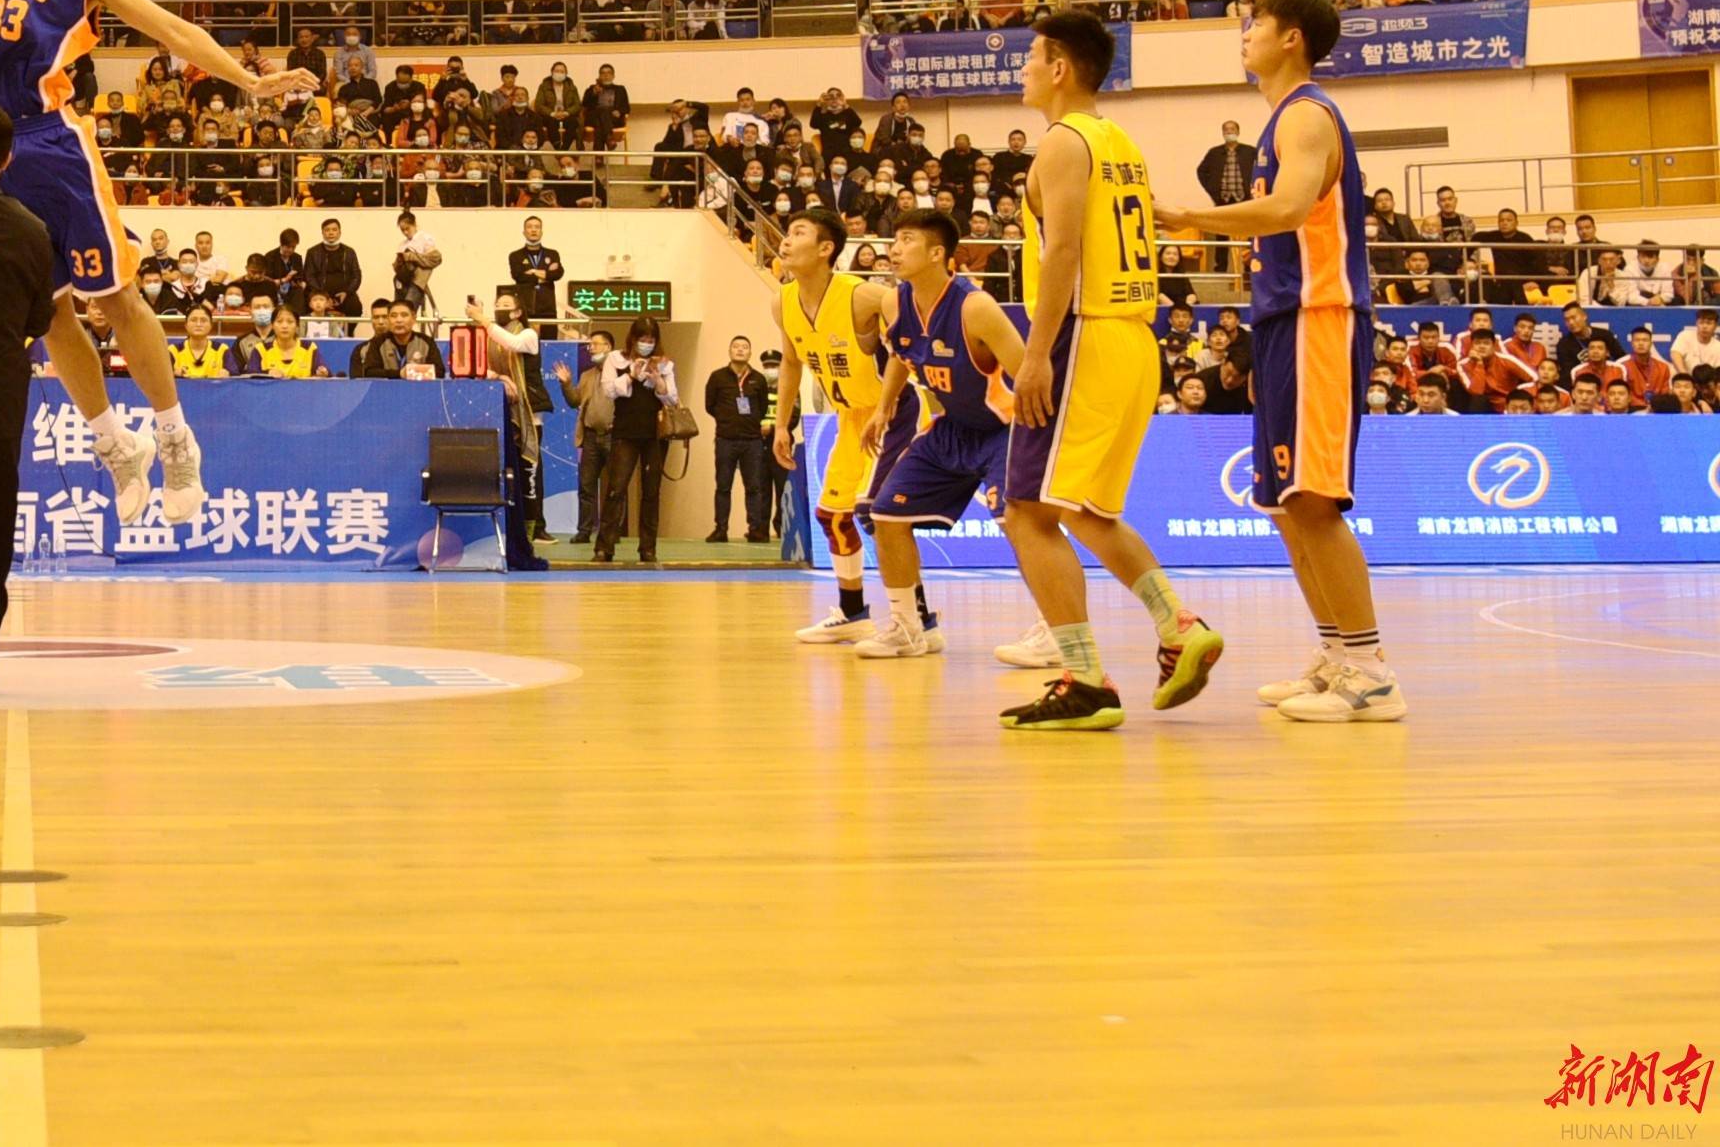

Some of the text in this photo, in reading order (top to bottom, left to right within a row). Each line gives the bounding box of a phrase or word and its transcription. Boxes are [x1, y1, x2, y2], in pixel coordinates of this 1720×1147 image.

[1113, 194, 1151, 272] 13
[70, 247, 104, 278] 33
[572, 289, 666, 312] 安全出口
[1273, 444, 1291, 480] 9
